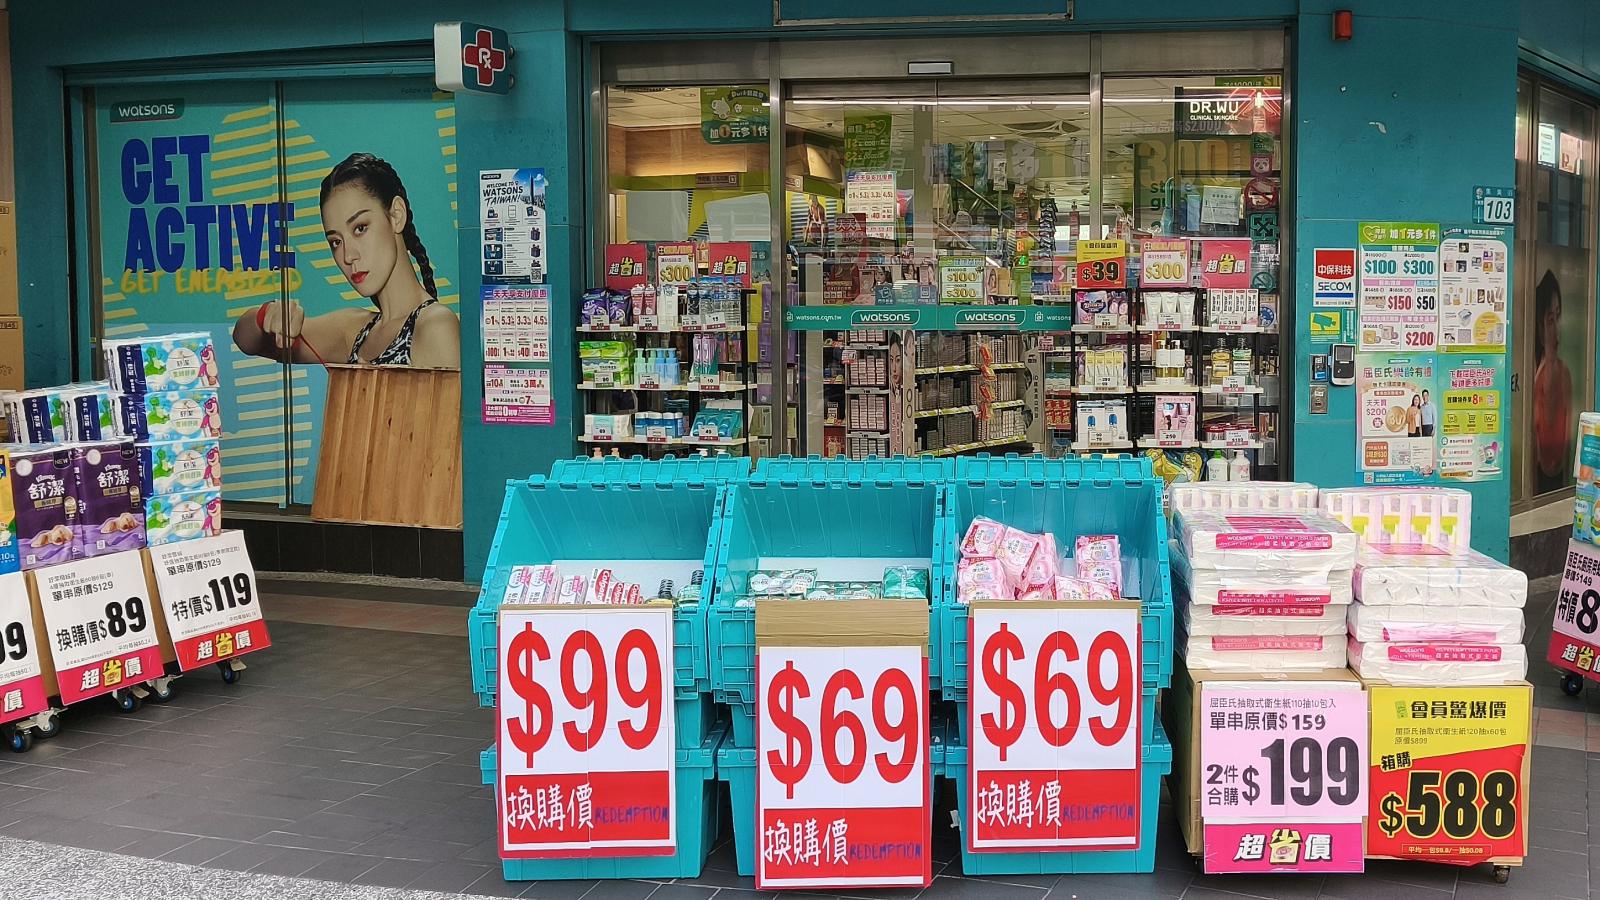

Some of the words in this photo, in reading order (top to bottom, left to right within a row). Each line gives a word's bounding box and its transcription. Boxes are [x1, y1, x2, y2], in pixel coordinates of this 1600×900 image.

[118, 103, 175, 118] watsons
[1190, 101, 1239, 114] DR.WU
[120, 134, 210, 205] GET
[483, 186, 523, 197] WATSONS
[484, 194, 521, 206] TAIWAN!
[1487, 201, 1512, 219] 103
[124, 202, 296, 274] ACTIVE
[1390, 228, 1436, 240] 加1元多1件
[608, 256, 643, 276] 超省價
[660, 265, 691, 282] $300
[711, 256, 747, 275] 超省價
[1082, 262, 1119, 281] $39
[1146, 262, 1184, 280] $300
[1205, 254, 1246, 274] 超省價
[1318, 265, 1352, 275] 中保科技
[1365, 260, 1396, 274] $100
[1403, 260, 1433, 274] $300
[120, 268, 166, 294] GET
[1318, 282, 1351, 291] SECOM
[1388, 296, 1412, 310] $150
[1417, 296, 1435, 310] $50
[860, 313, 910, 321] watsons
[1406, 332, 1434, 346] $200
[1363, 367, 1432, 378] 屈臣氏樂齡有禮
[1450, 368, 1495, 378] 下載屈臣氏APP
[97, 469, 130, 488] 舒潔
[28, 479, 65, 499] 舒潔
[167, 558, 222, 576] 單串原價$129
[1565, 569, 1592, 587] 原價$149
[52, 581, 114, 602] 單串原價$129
[171, 572, 252, 621] 特價$119
[56, 597, 146, 651] 換購價$89
[0, 622, 27, 664] 9
[197, 632, 253, 661] 超省價
[80, 659, 142, 691] 超省價
[4, 688, 24, 713] 價
[506, 622, 662, 769] $99
[980, 622, 1133, 762] $69
[1210, 698, 1336, 709] 屈臣氏抽取式衛生紙110抽10包入
[1411, 701, 1507, 719] 會員驚爆價
[766, 660, 919, 800] $69
[1395, 736, 1428, 745] 原價$899
[1381, 752, 1412, 770] 箱購
[1206, 764, 1239, 784] 2件
[1242, 736, 1360, 806] $199
[978, 779, 1062, 828] 換購價
[1063, 803, 1135, 822] REDEMPTION
[1208, 787, 1239, 806] 合購
[1380, 771, 1516, 838] $588
[508, 783, 594, 831] 換購價
[595, 806, 670, 824] REDEMPTION
[764, 818, 849, 867] 換購價
[850, 842, 922, 860] REDEMPTION
[1232, 828, 1333, 865] 超省價
